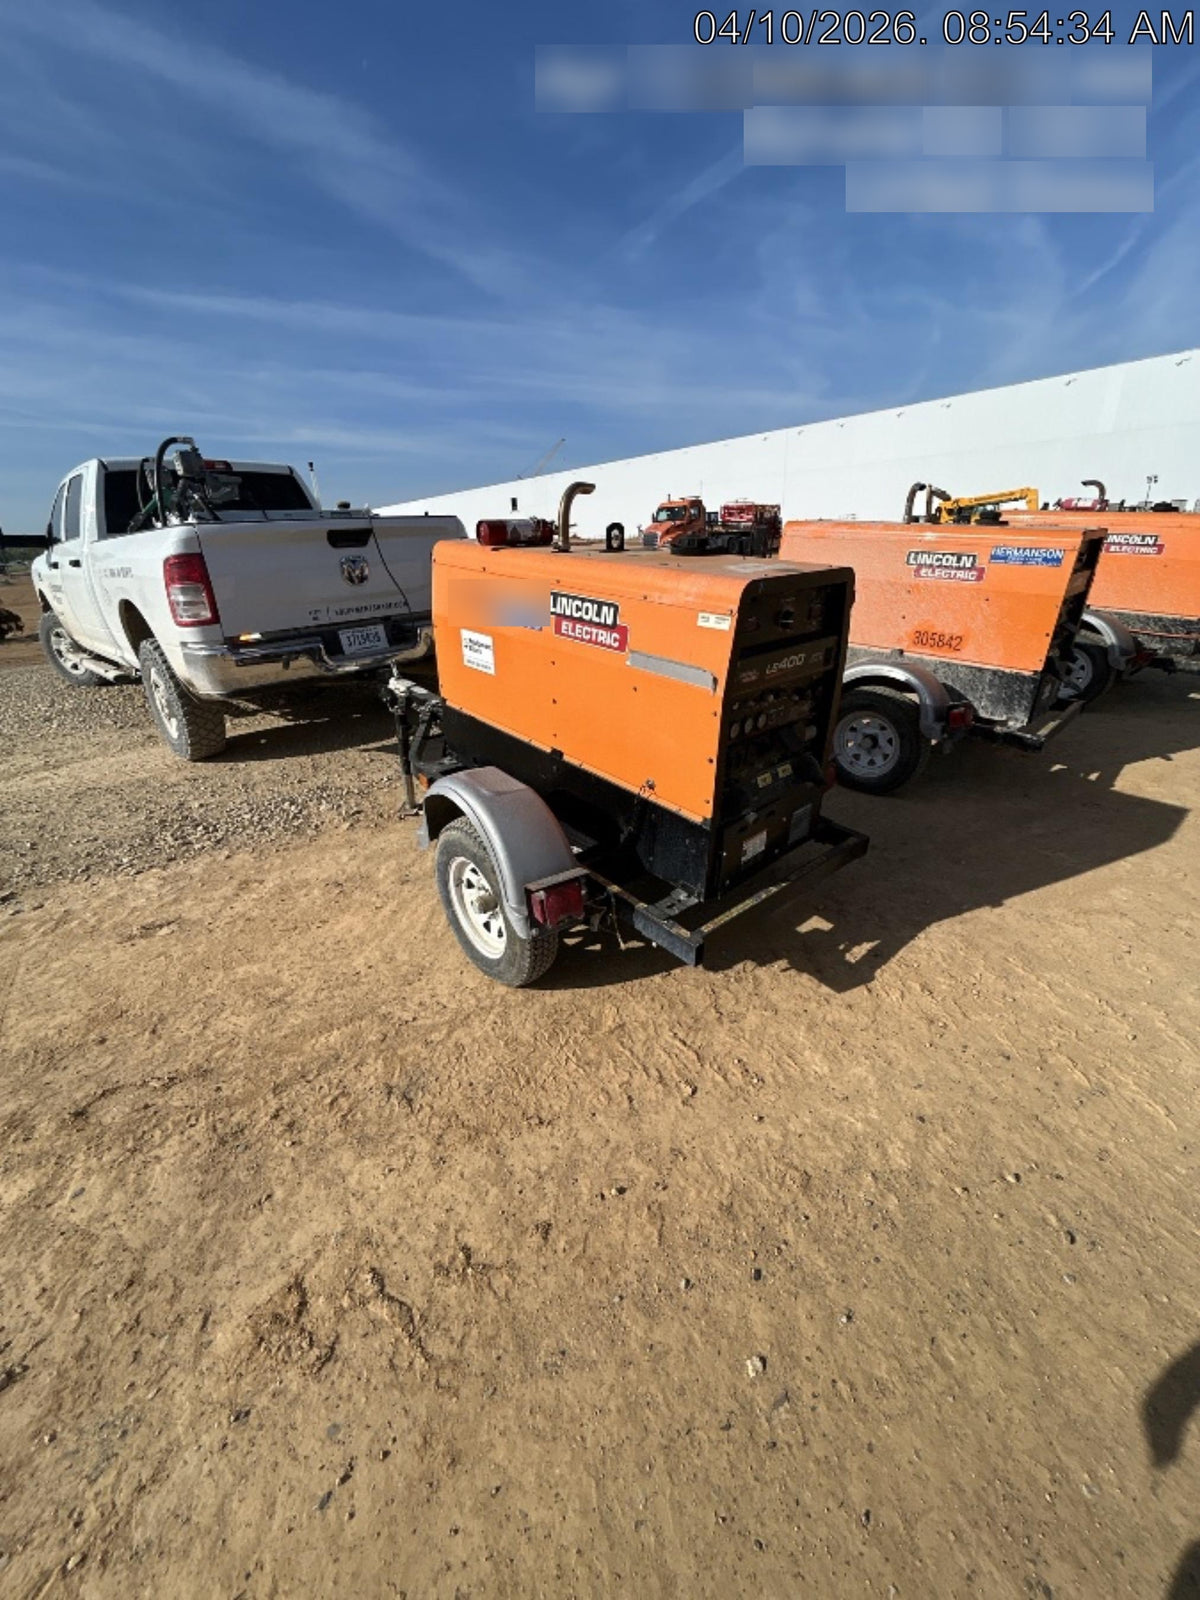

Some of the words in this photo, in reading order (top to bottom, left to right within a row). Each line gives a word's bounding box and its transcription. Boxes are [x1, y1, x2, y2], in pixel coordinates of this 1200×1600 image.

[1103, 533, 1157, 546] INCOLN
[991, 546, 1064, 559] HERMANSON
[1109, 544, 1159, 555] ELECTRIC
[908, 552, 974, 569] LINCOLN
[919, 567, 977, 581] ELECTRIC
[550, 594, 615, 626] LINCOLN
[560, 620, 620, 648] ELECTRIC
[913, 630, 963, 652] 305842
